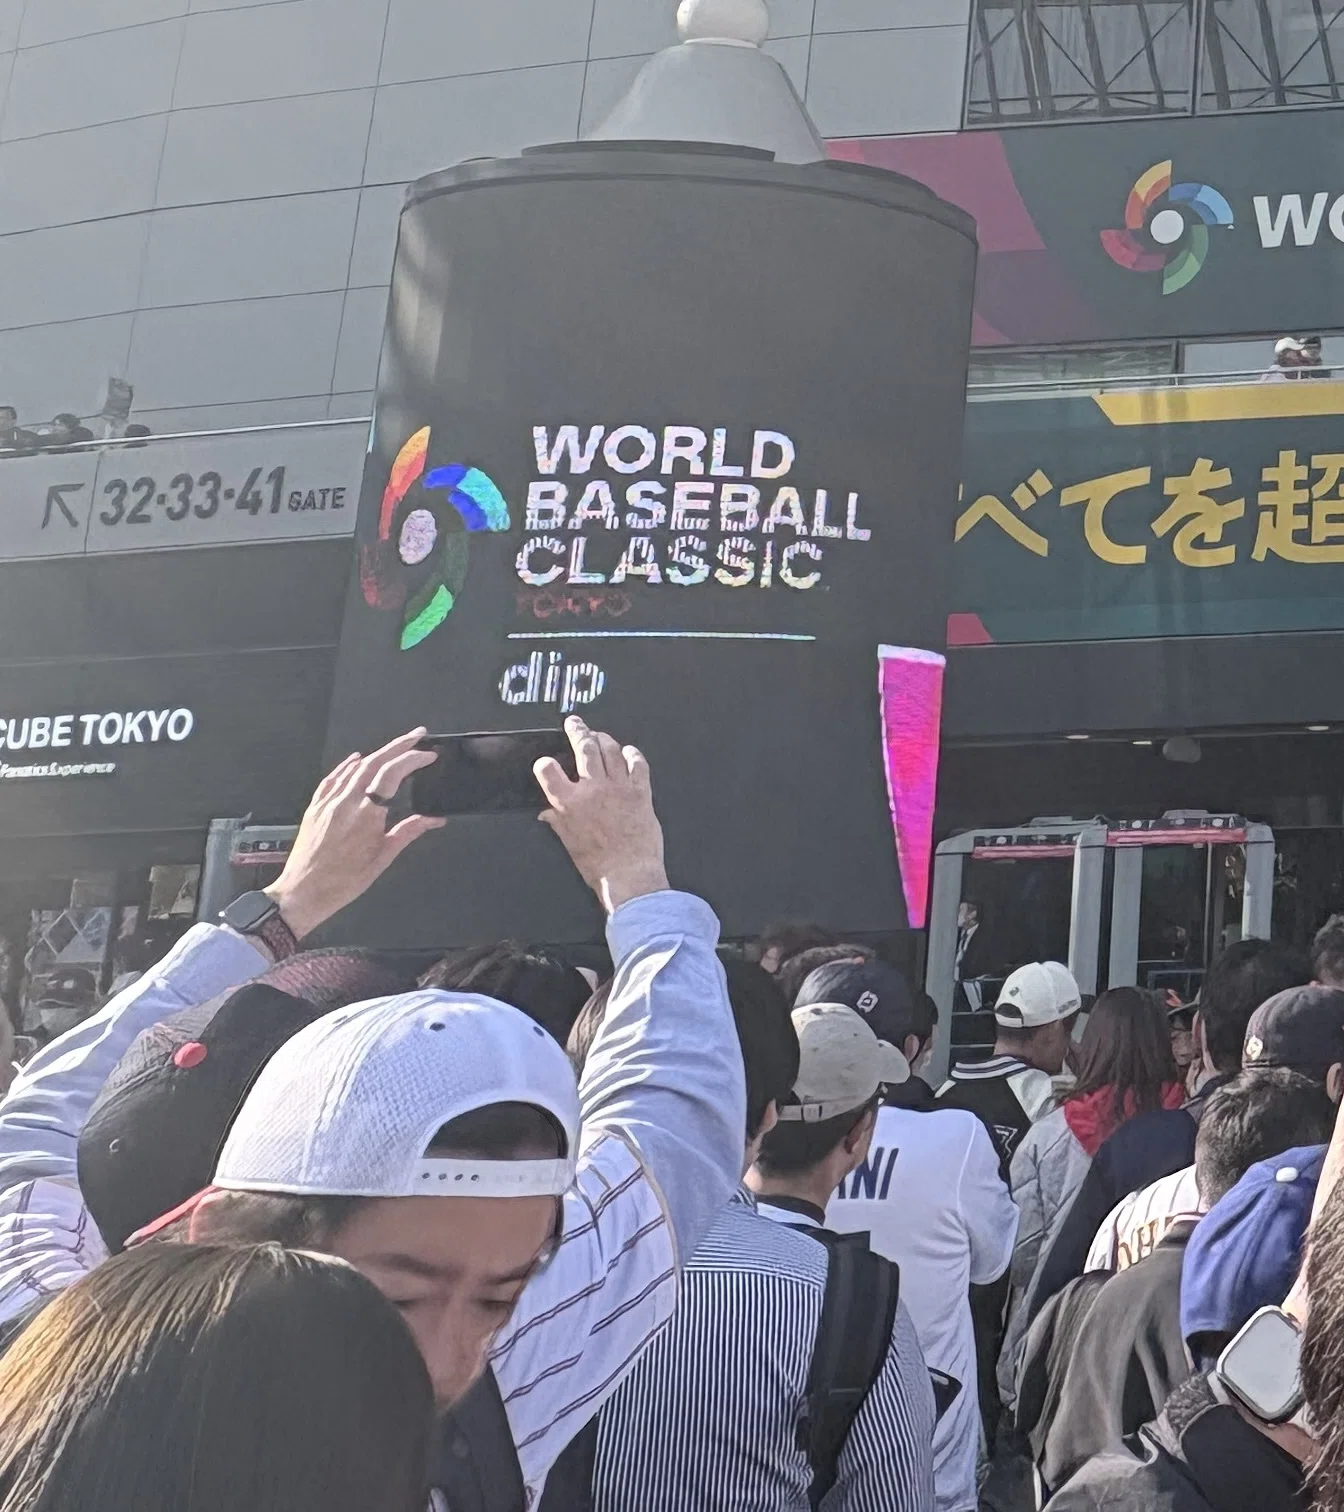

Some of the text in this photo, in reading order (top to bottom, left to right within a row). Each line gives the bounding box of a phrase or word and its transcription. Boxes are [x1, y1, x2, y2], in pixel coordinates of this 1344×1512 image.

[532, 424, 796, 479] WORLD
[287, 488, 347, 513] GATE
[524, 480, 872, 541] BASEBALL
[515, 535, 824, 590] CLASSIC
[498, 650, 608, 714] dip
[79, 707, 195, 746] TOKYO
[837, 1146, 900, 1201] NI
